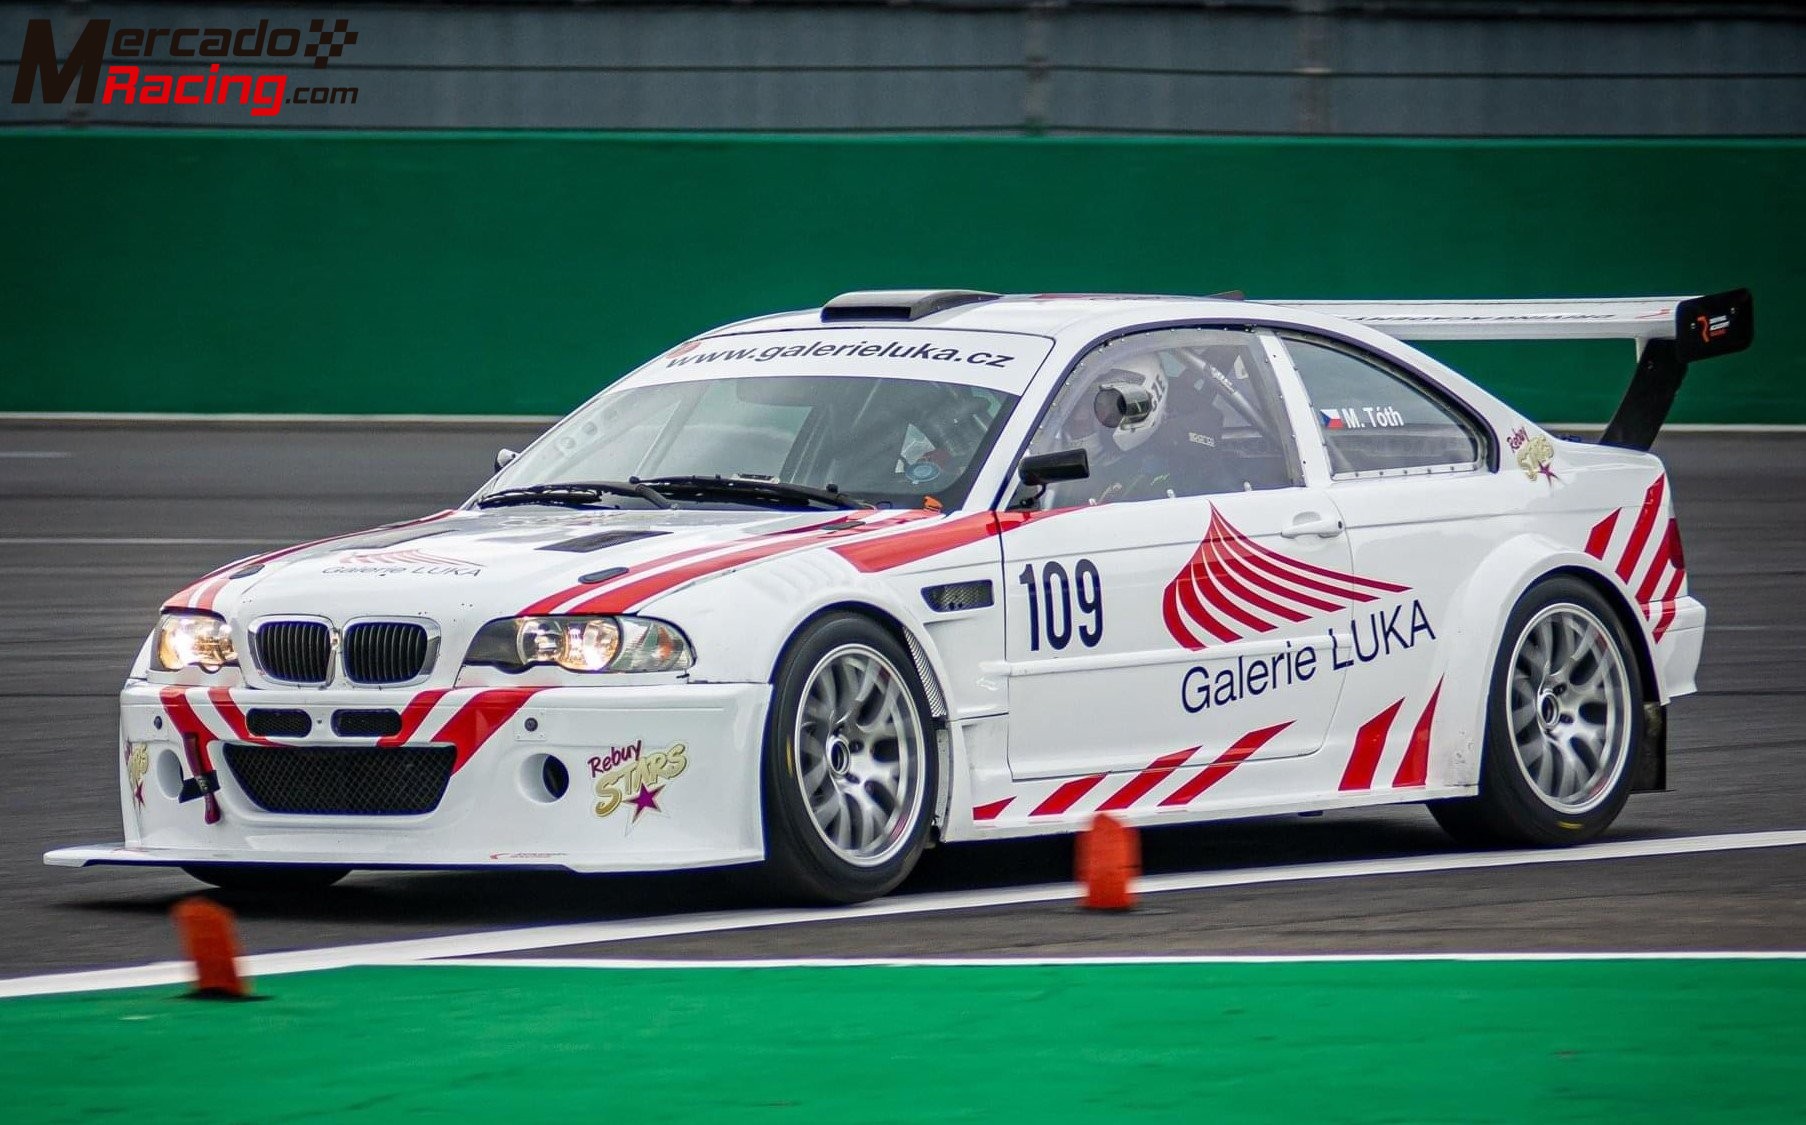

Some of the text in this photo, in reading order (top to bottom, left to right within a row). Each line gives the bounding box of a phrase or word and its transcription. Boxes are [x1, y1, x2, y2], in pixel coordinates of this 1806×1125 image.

[665, 340, 1016, 369] www.galerieluka.cz
[1341, 406, 1404, 429] M. Tóth
[1019, 558, 1104, 652] 109
[1181, 599, 1437, 714] Galerie LUKA
[587, 740, 642, 778] Rebuy
[595, 743, 688, 818] STARS
